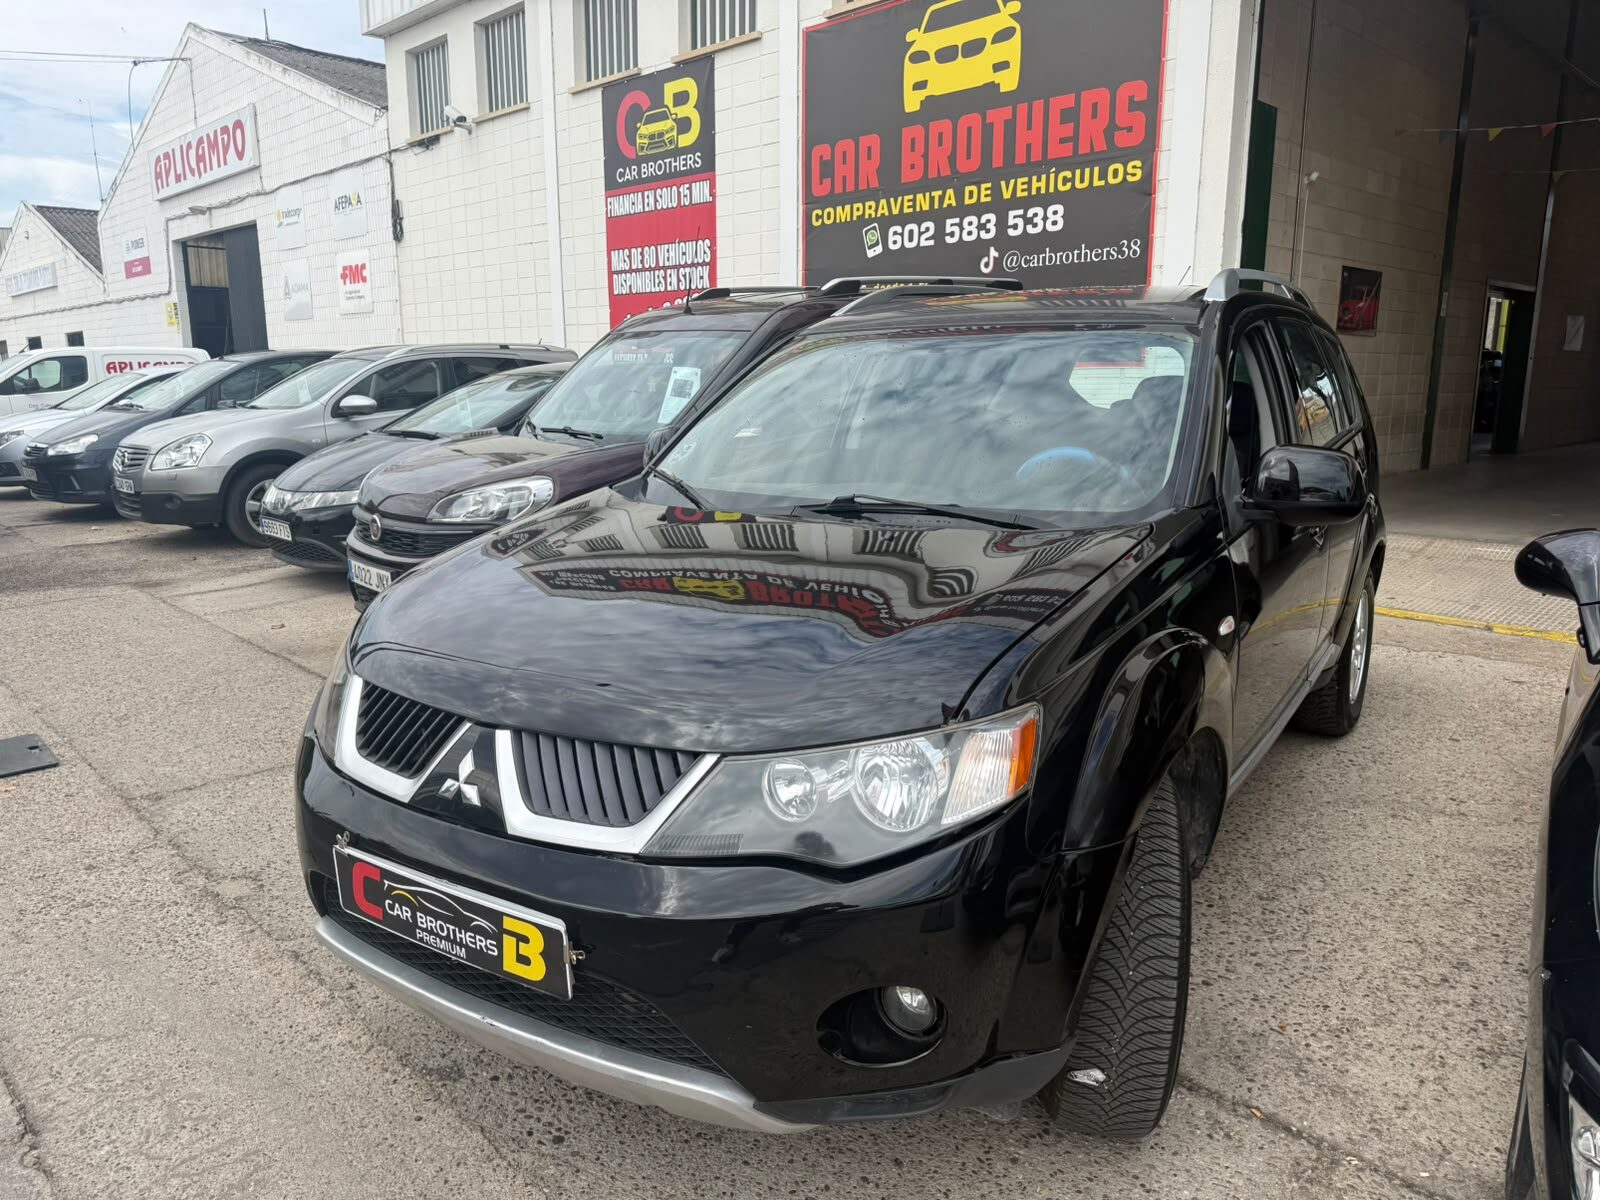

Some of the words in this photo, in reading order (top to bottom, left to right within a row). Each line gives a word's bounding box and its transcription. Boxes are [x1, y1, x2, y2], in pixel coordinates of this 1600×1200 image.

[154, 118, 246, 194] APLICAMPO
[811, 133, 881, 197] CAR
[901, 80, 1148, 184] BROTHERS
[616, 165, 639, 183] CAR
[641, 152, 702, 178] BROTHERS
[607, 191, 643, 217] FINANCIA
[644, 190, 655, 212] EN
[656, 186, 678, 210] SOLO
[679, 184, 690, 206] 15
[691, 180, 713, 204] MIN.
[811, 188, 957, 227] COMPRAVENTA
[964, 182, 992, 205] DE
[1000, 160, 1143, 200] VEHÍCULOS
[888, 221, 935, 250] 602
[944, 213, 997, 244] 583
[1007, 204, 1065, 237] 538
[340, 263, 367, 285] FMC
[611, 248, 630, 272] MAS
[631, 247, 642, 270] DE
[643, 245, 656, 268] 80
[657, 238, 711, 266] VEHÍCULOS
[1003, 238, 1141, 272] @carbrothers38
[613, 270, 665, 295] DISPONIBLES
[666, 268, 678, 291] EN
[679, 265, 710, 290] STOCK
[352, 861, 384, 921] C
[385, 899, 413, 923] CAR
[416, 911, 498, 956] BROTHERS
[416, 929, 467, 960] PREMIUM
[503, 915, 546, 982] B
